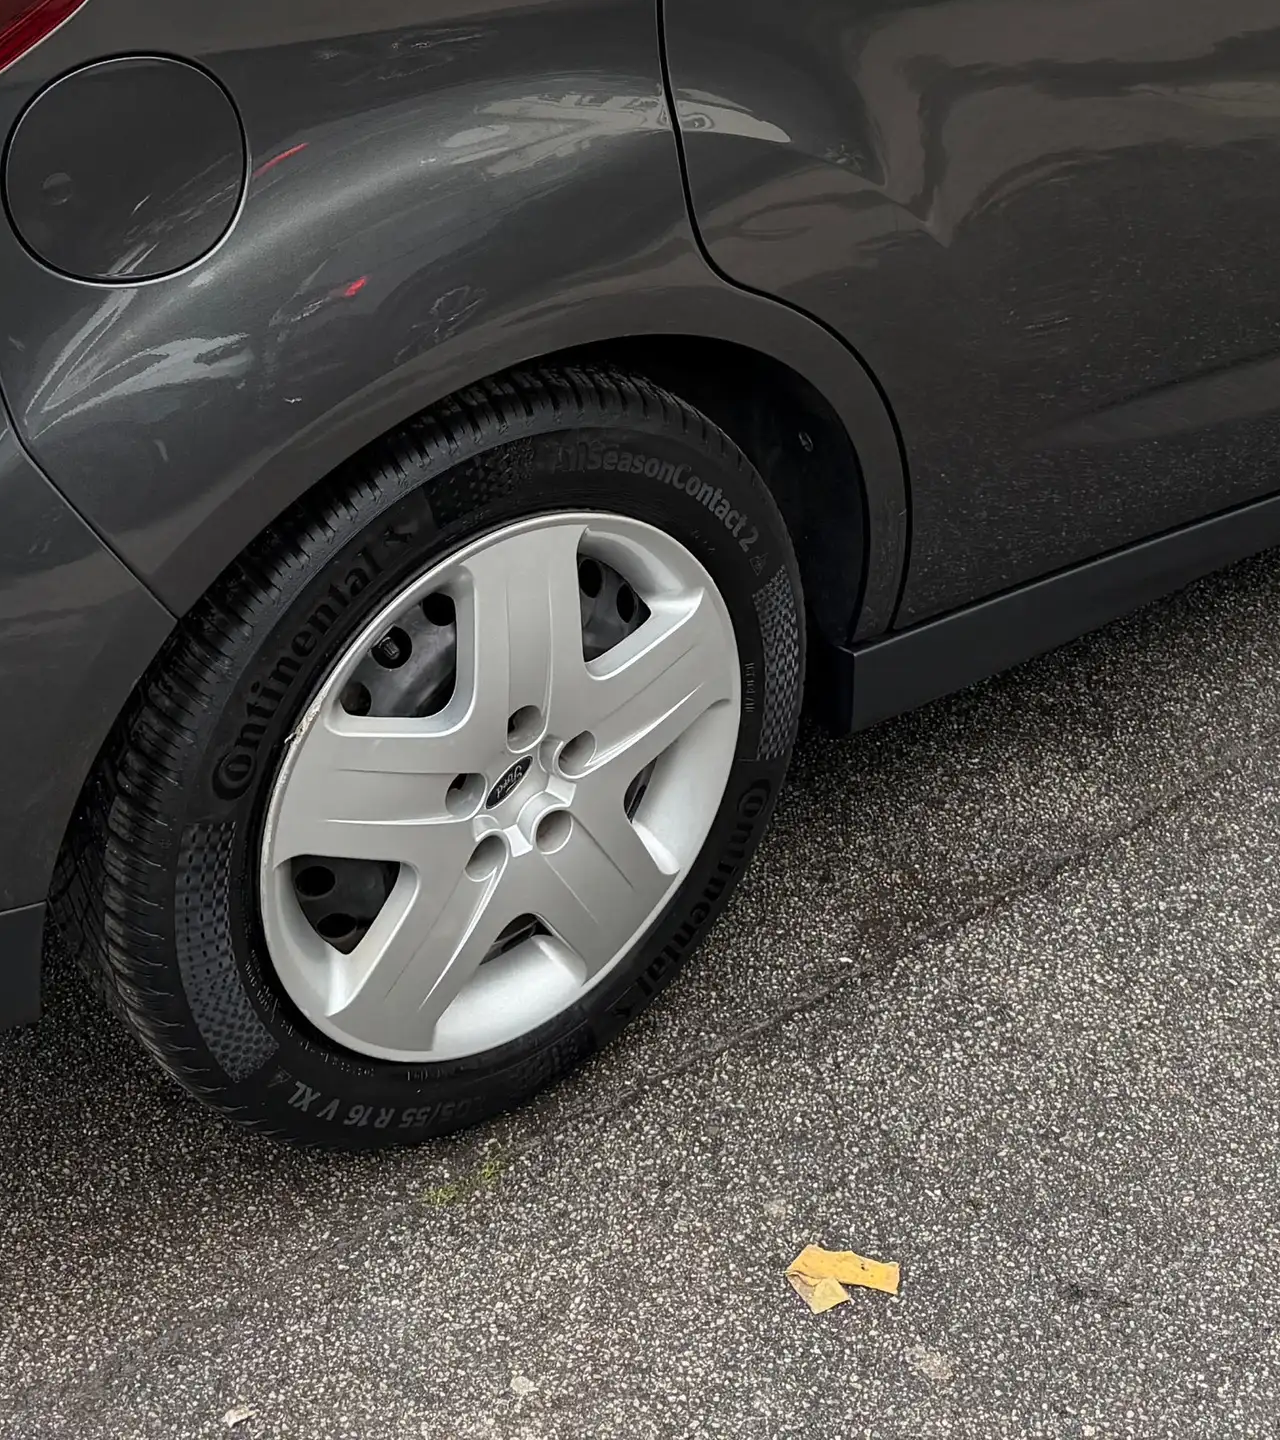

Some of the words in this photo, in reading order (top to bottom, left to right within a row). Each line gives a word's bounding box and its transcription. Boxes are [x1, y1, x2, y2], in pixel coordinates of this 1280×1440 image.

[738, 526, 760, 553] 2
[212, 546, 386, 801] Continental
[496, 765, 522, 799] Ford
